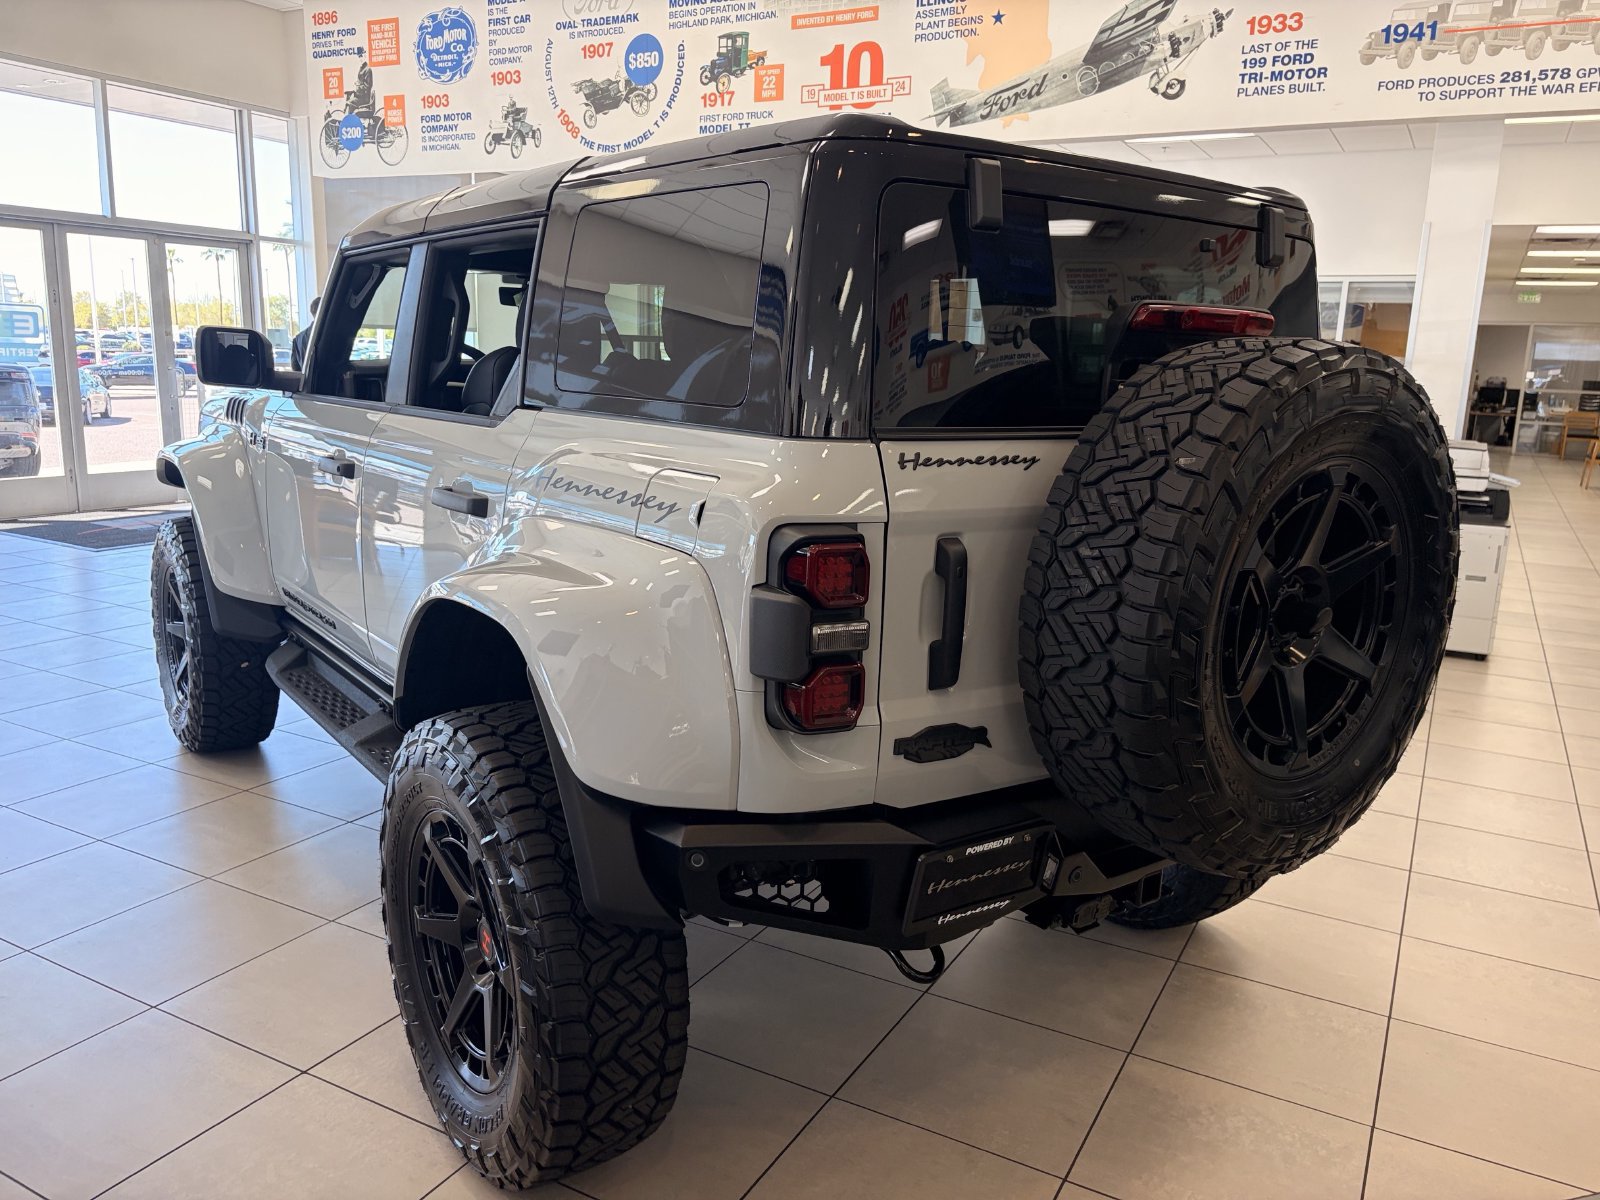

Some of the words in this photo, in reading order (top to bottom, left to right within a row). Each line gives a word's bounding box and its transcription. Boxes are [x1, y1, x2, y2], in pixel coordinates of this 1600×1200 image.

[488, 8, 494, 16] IS
[495, 7, 508, 15] THE
[669, 8, 697, 19] BEGINS
[700, 3, 746, 15] OPERATION
[748, 2, 756, 10] IN
[797, 16, 825, 26] INVENTED
[826, 15, 834, 23] BY
[836, 12, 856, 22] HENRY
[857, 10, 875, 20] FORD.
[915, 5, 967, 19] ASSEMBLY
[312, 11, 338, 26] 1896
[488, 17, 511, 27] FIRST
[513, 14, 531, 25] CAR
[555, 20, 578, 30] OVAL
[581, 13, 640, 28] TRADEMARK
[669, 17, 708, 30] HIGHLAND
[710, 15, 733, 25] PARK,
[735, 10, 779, 23] MICHIGAN.
[915, 20, 945, 31] PLANT
[948, 15, 984, 28] BEGINS
[1246, 12, 1304, 35] 1933
[312, 30, 335, 40] HENRY
[337, 28, 356, 38] FORD
[371, 24, 380, 32] THE
[443, 28, 467, 43] MOTOR
[488, 26, 526, 37] PRODUCED
[569, 31, 575, 39] IS
[577, 27, 625, 38] INTRODUCED.
[915, 28, 980, 43] PRODUCTION.
[1381, 20, 1438, 44] 1941
[312, 41, 332, 49] DRIVES
[371, 38, 396, 50] VEHICLE
[489, 46, 507, 56] FORD
[508, 45, 532, 55] MOTOR
[581, 42, 614, 59] 1907
[1241, 43, 1272, 55] LAST
[1274, 41, 1291, 52] OF
[1294, 38, 1319, 50] THE
[489, 56, 523, 66] COMPANY.
[545, 38, 554, 82] AUGUST
[629, 51, 659, 70] $850
[1241, 57, 1267, 69] 199
[1272, 52, 1315, 67] FORD
[491, 70, 521, 86] 1903
[667, 39, 685, 110] PRODUCED.
[820, 41, 884, 110] 10
[1239, 67, 1328, 84] TRI-MOTOR
[1377, 79, 1415, 91] FORD
[1418, 73, 1495, 88] PRODUCES
[1499, 67, 1572, 84] 281,578
[329, 77, 338, 88] 20
[763, 76, 776, 89] 22
[895, 80, 906, 92] 24
[1237, 84, 1285, 97] PLANES
[1288, 82, 1326, 94] BUILT.
[547, 85, 559, 109] 12TH
[701, 90, 735, 108] 1917
[762, 89, 776, 98] MPH
[806, 88, 816, 100] 19
[824, 91, 848, 102] MODEL
[850, 91, 856, 100] T
[857, 90, 865, 99] IS
[867, 88, 887, 99] BUILT
[980, 72, 1049, 120] Ford
[1418, 91, 1436, 102] TO
[1439, 86, 1506, 101] SUPPORT
[1509, 84, 1538, 97] THE
[1541, 83, 1575, 95] WAR
[1579, 81, 1600, 93] EF
[421, 94, 449, 109] 1903
[421, 114, 441, 123] FORD
[444, 112, 472, 122] MOTOR
[660, 109, 669, 122] IS
[700, 114, 720, 123] FIRST
[723, 113, 744, 121] FORD
[746, 110, 774, 120] TRUCK
[421, 124, 459, 134] COMPANY
[557, 108, 580, 139] 1908
[653, 120, 661, 129] T
[341, 127, 361, 139] $200
[428, 133, 475, 142] INCORPORATED
[623, 128, 655, 151] MODEL
[429, 143, 461, 151] MICHIGAN.
[579, 135, 596, 151] THE
[597, 143, 621, 153] FIRST
[898, 451, 1040, 471] Hennessey
[535, 467, 682, 523] Hennessey
[965, 840, 1003, 856] POWERED
[1003, 836, 1014, 846] BY
[927, 859, 1033, 895] Hennessey
[937, 900, 1010, 925] Hennessey
